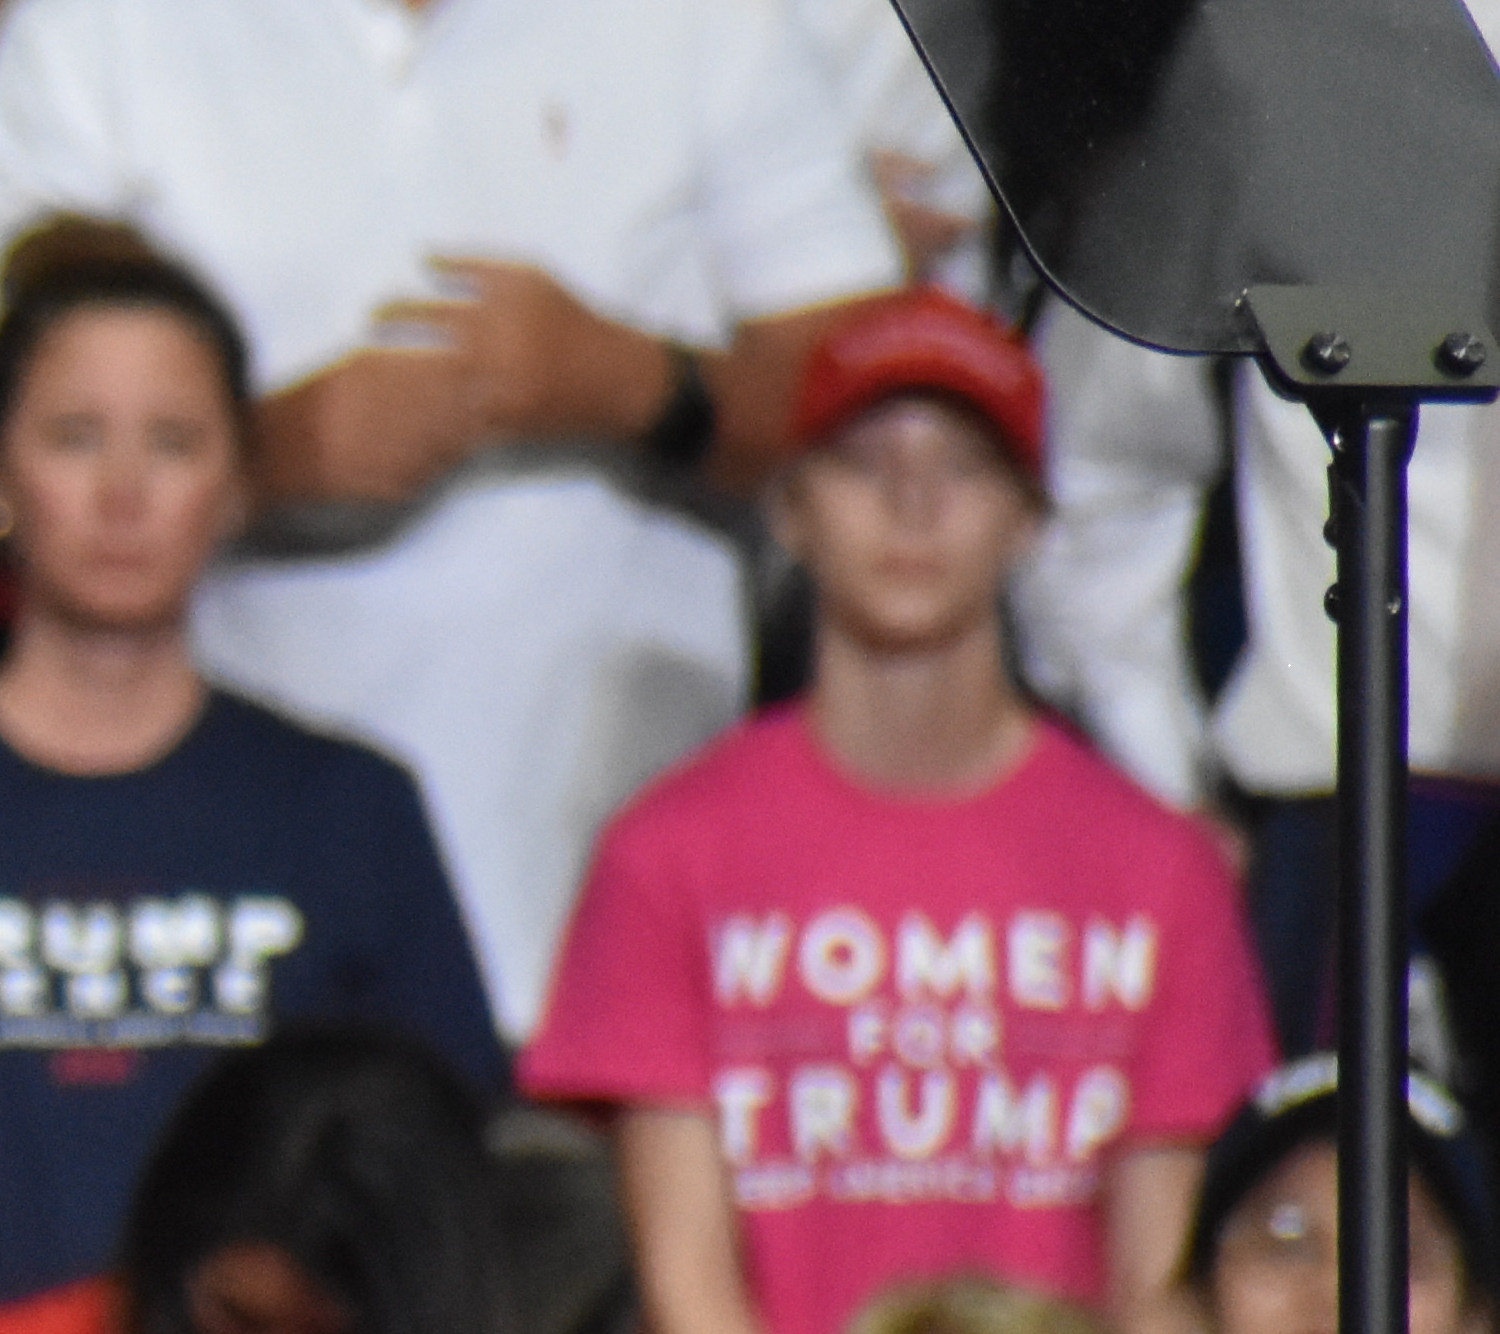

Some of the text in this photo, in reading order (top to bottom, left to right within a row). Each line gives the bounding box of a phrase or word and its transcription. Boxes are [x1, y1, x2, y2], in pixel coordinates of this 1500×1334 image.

[709, 904, 1159, 1013] WOMEN
[848, 999, 1000, 1069] FOR
[712, 1065, 1132, 1167] TRUMP
